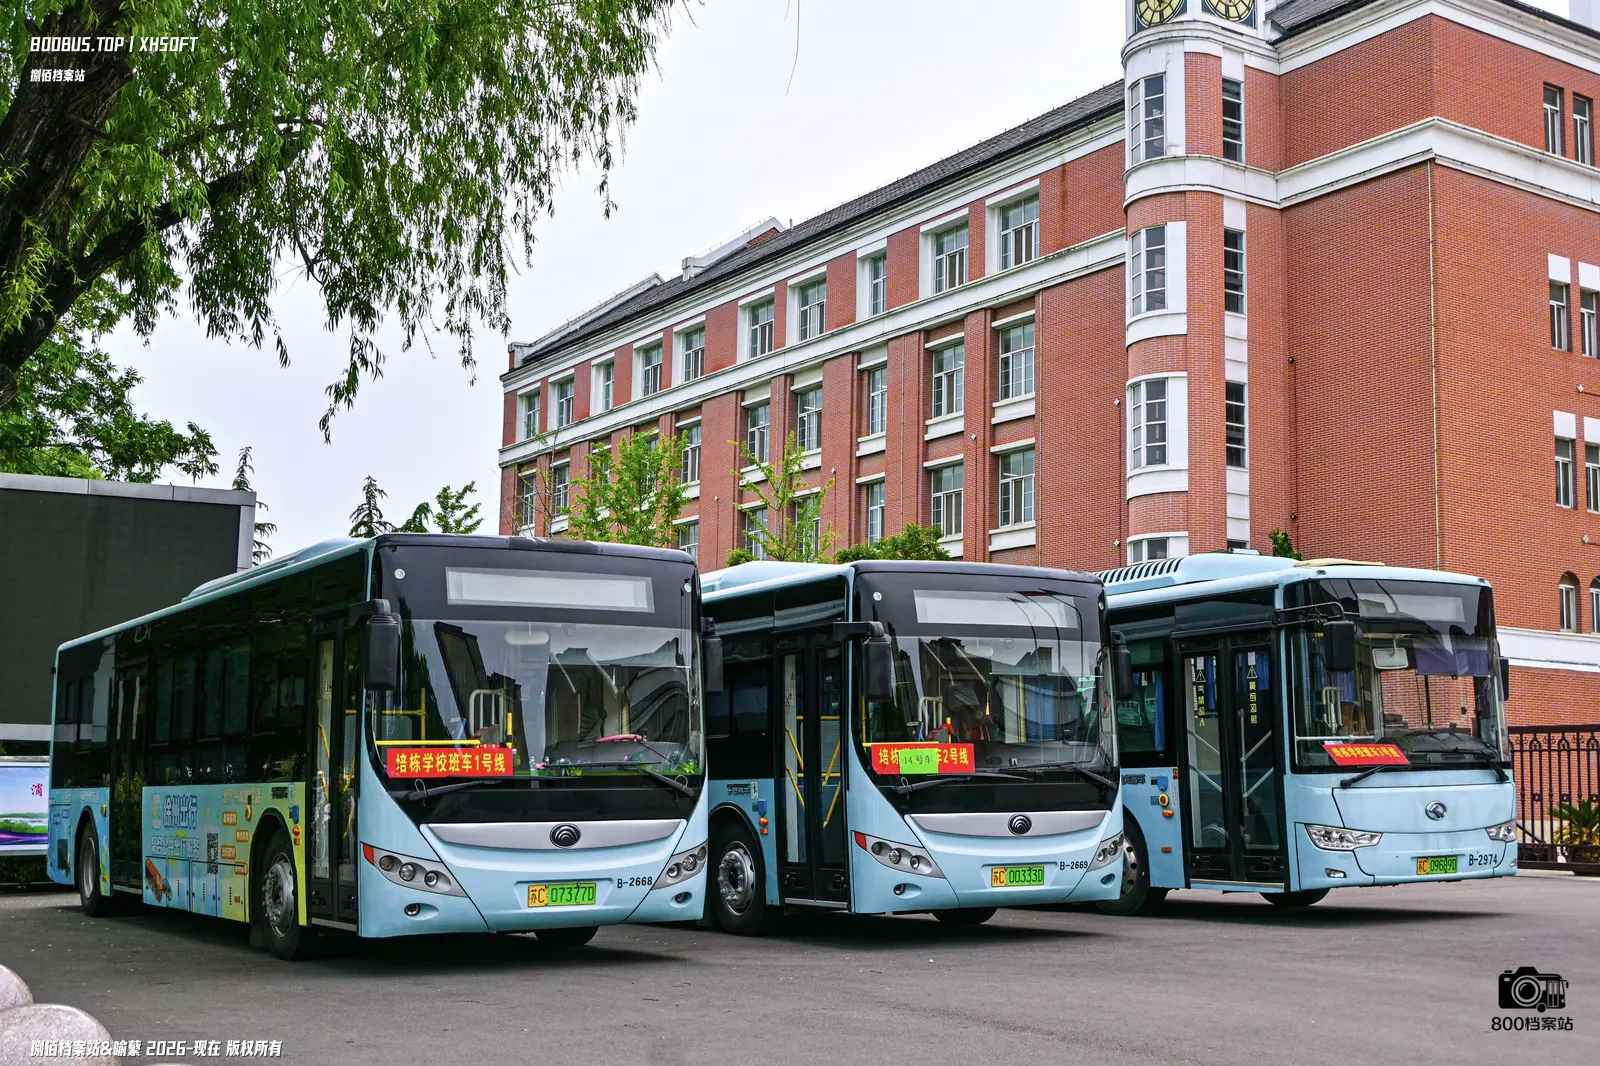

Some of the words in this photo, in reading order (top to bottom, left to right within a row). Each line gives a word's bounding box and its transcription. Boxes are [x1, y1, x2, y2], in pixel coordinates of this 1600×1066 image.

[395, 753, 506, 773] 培栋学校班车1号线
[1059, 860, 1089, 871] B-2669
[1468, 854, 1498, 866] B-2974
[617, 876, 653, 889] B-2668
